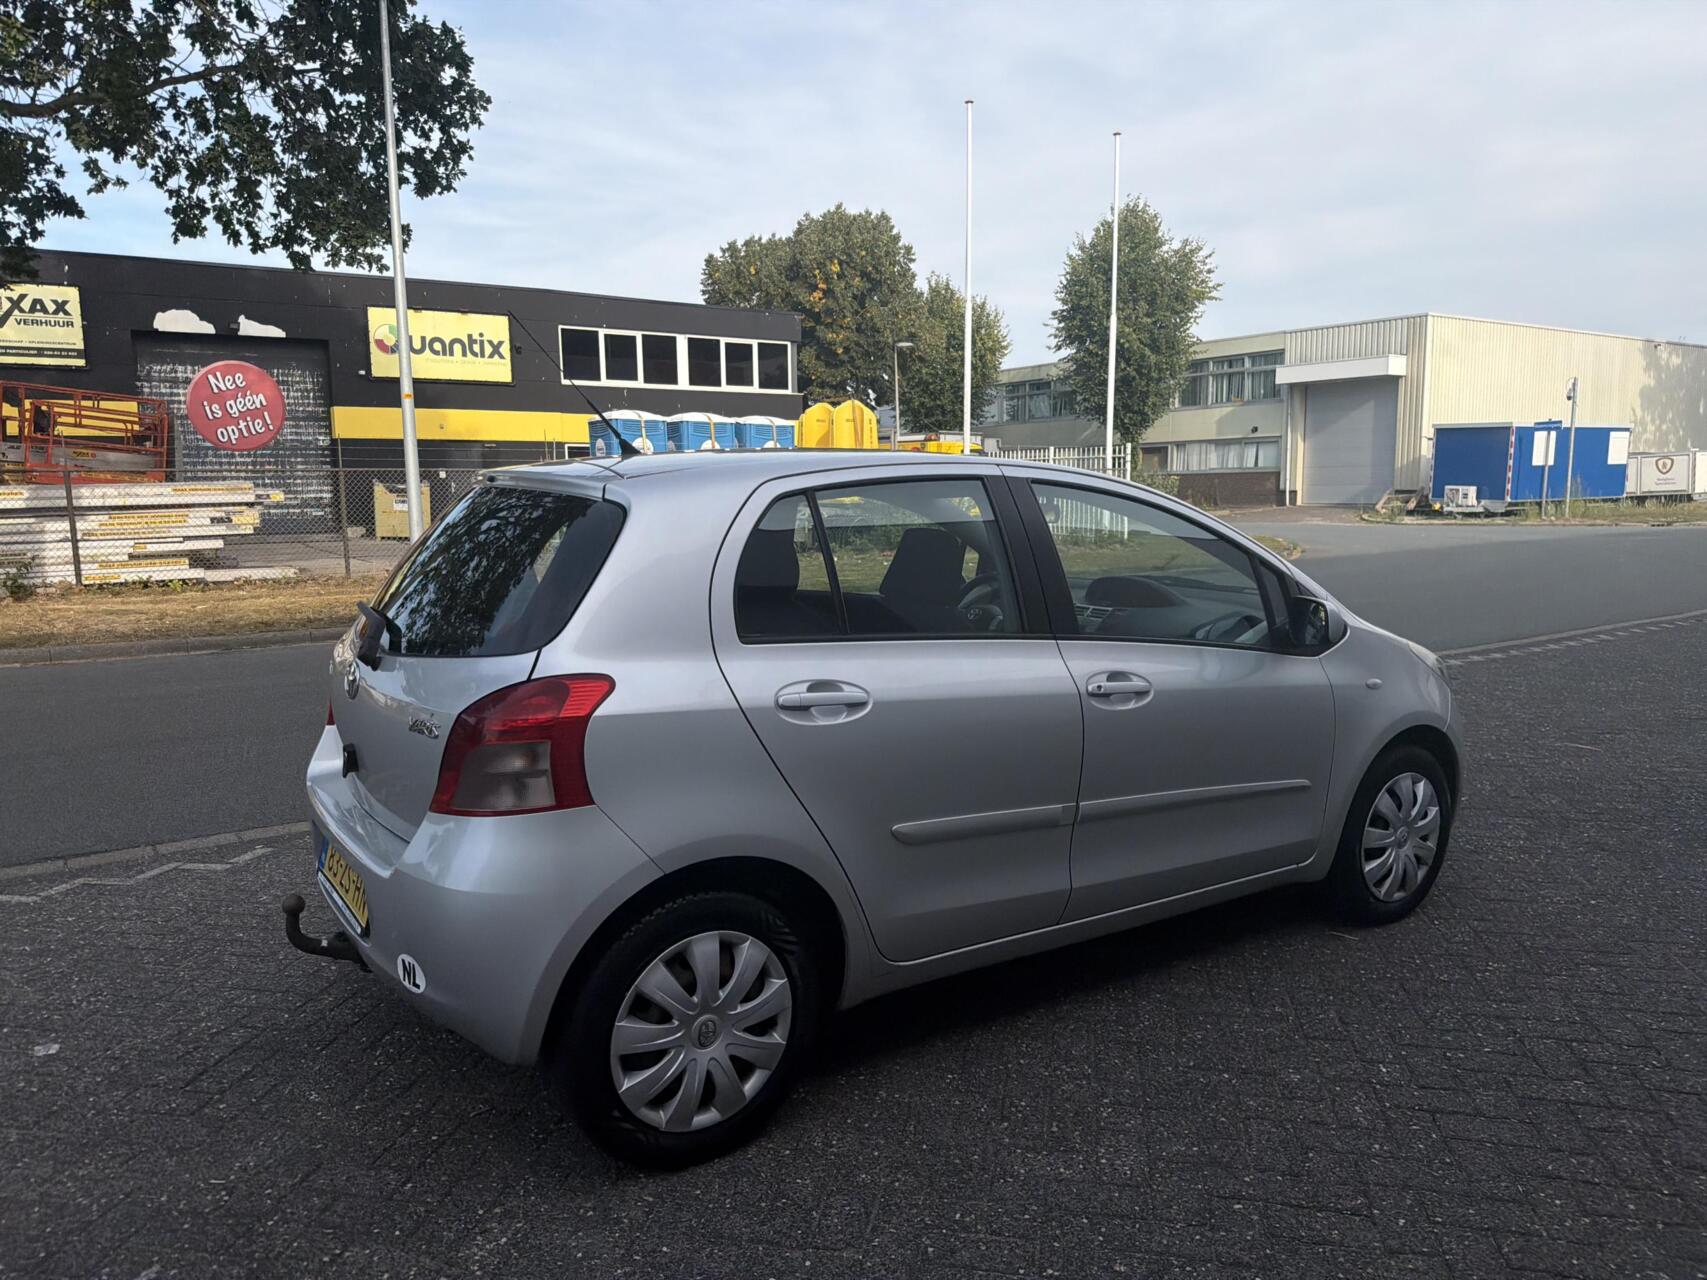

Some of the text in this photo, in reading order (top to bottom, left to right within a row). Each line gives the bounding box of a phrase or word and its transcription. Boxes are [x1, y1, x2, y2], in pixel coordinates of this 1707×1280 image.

[14, 317, 74, 328] VERHUUR
[207, 371, 246, 393] Nee
[203, 390, 267, 420] is géén
[401, 958, 421, 990] NL
